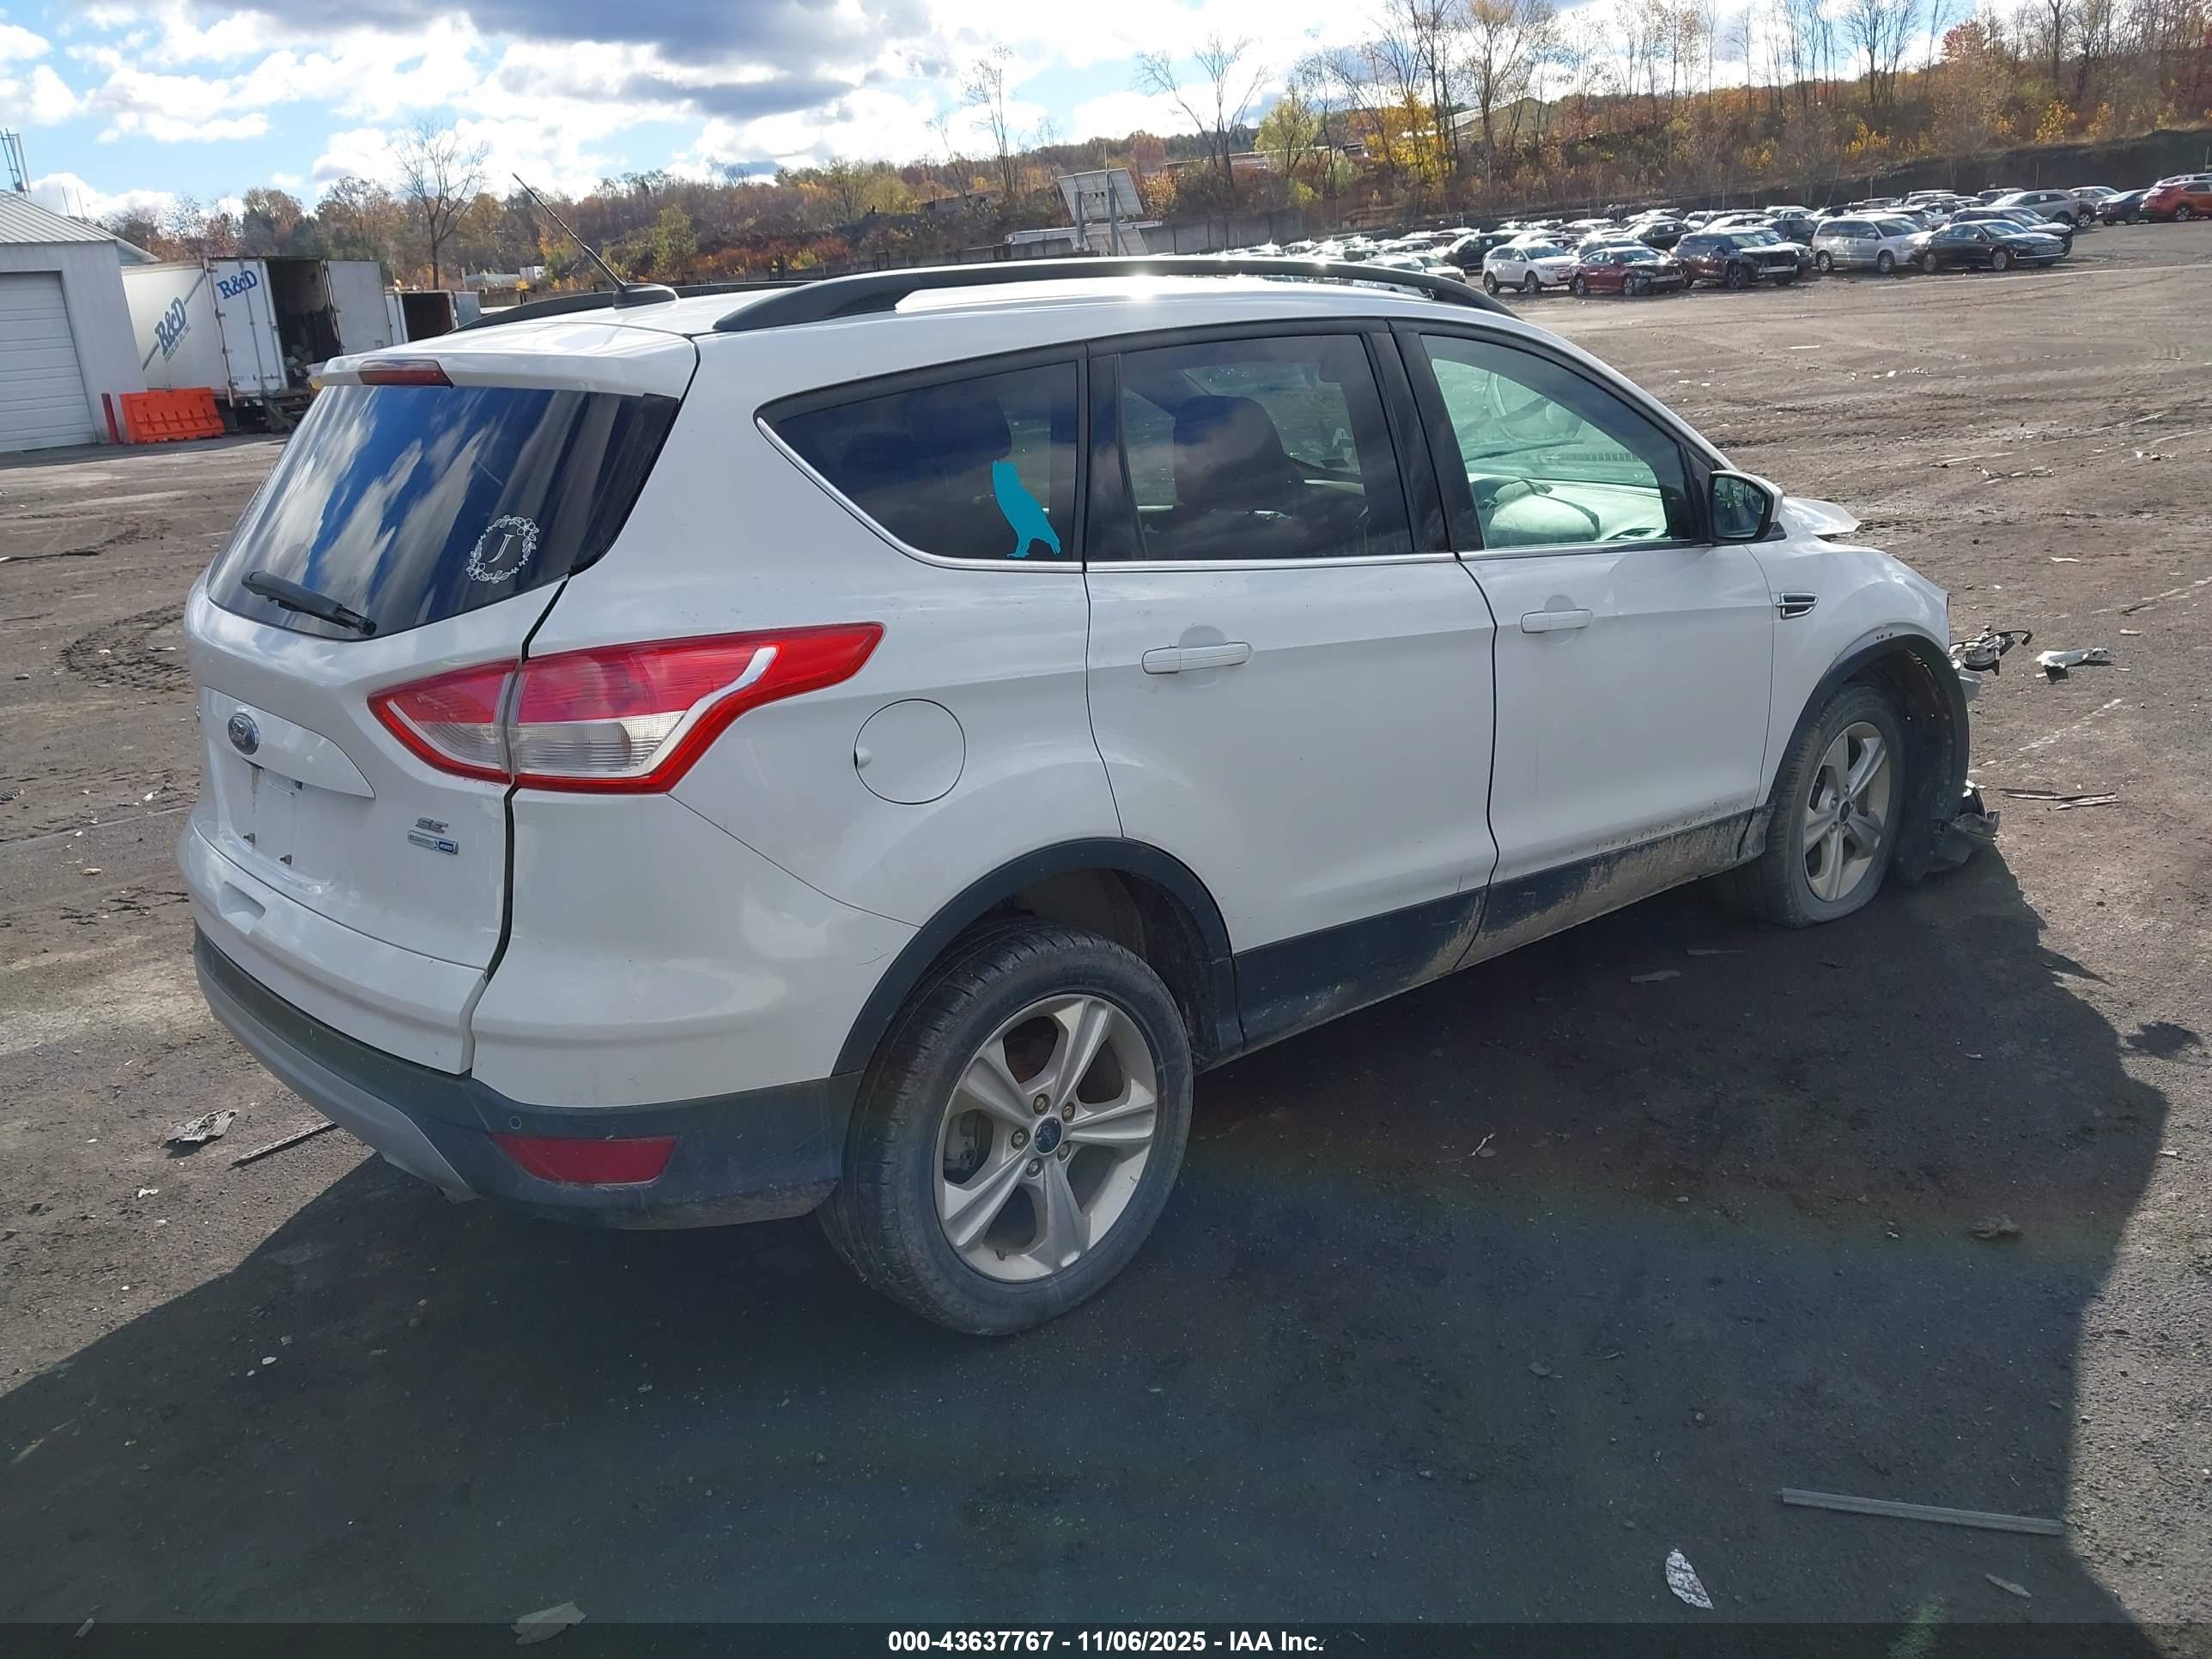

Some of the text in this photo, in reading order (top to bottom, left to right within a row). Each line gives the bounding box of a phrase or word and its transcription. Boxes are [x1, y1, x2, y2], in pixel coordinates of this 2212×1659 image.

[216, 270, 258, 300] R&D
[155, 296, 186, 356] R&D
[415, 817, 448, 834] SE
